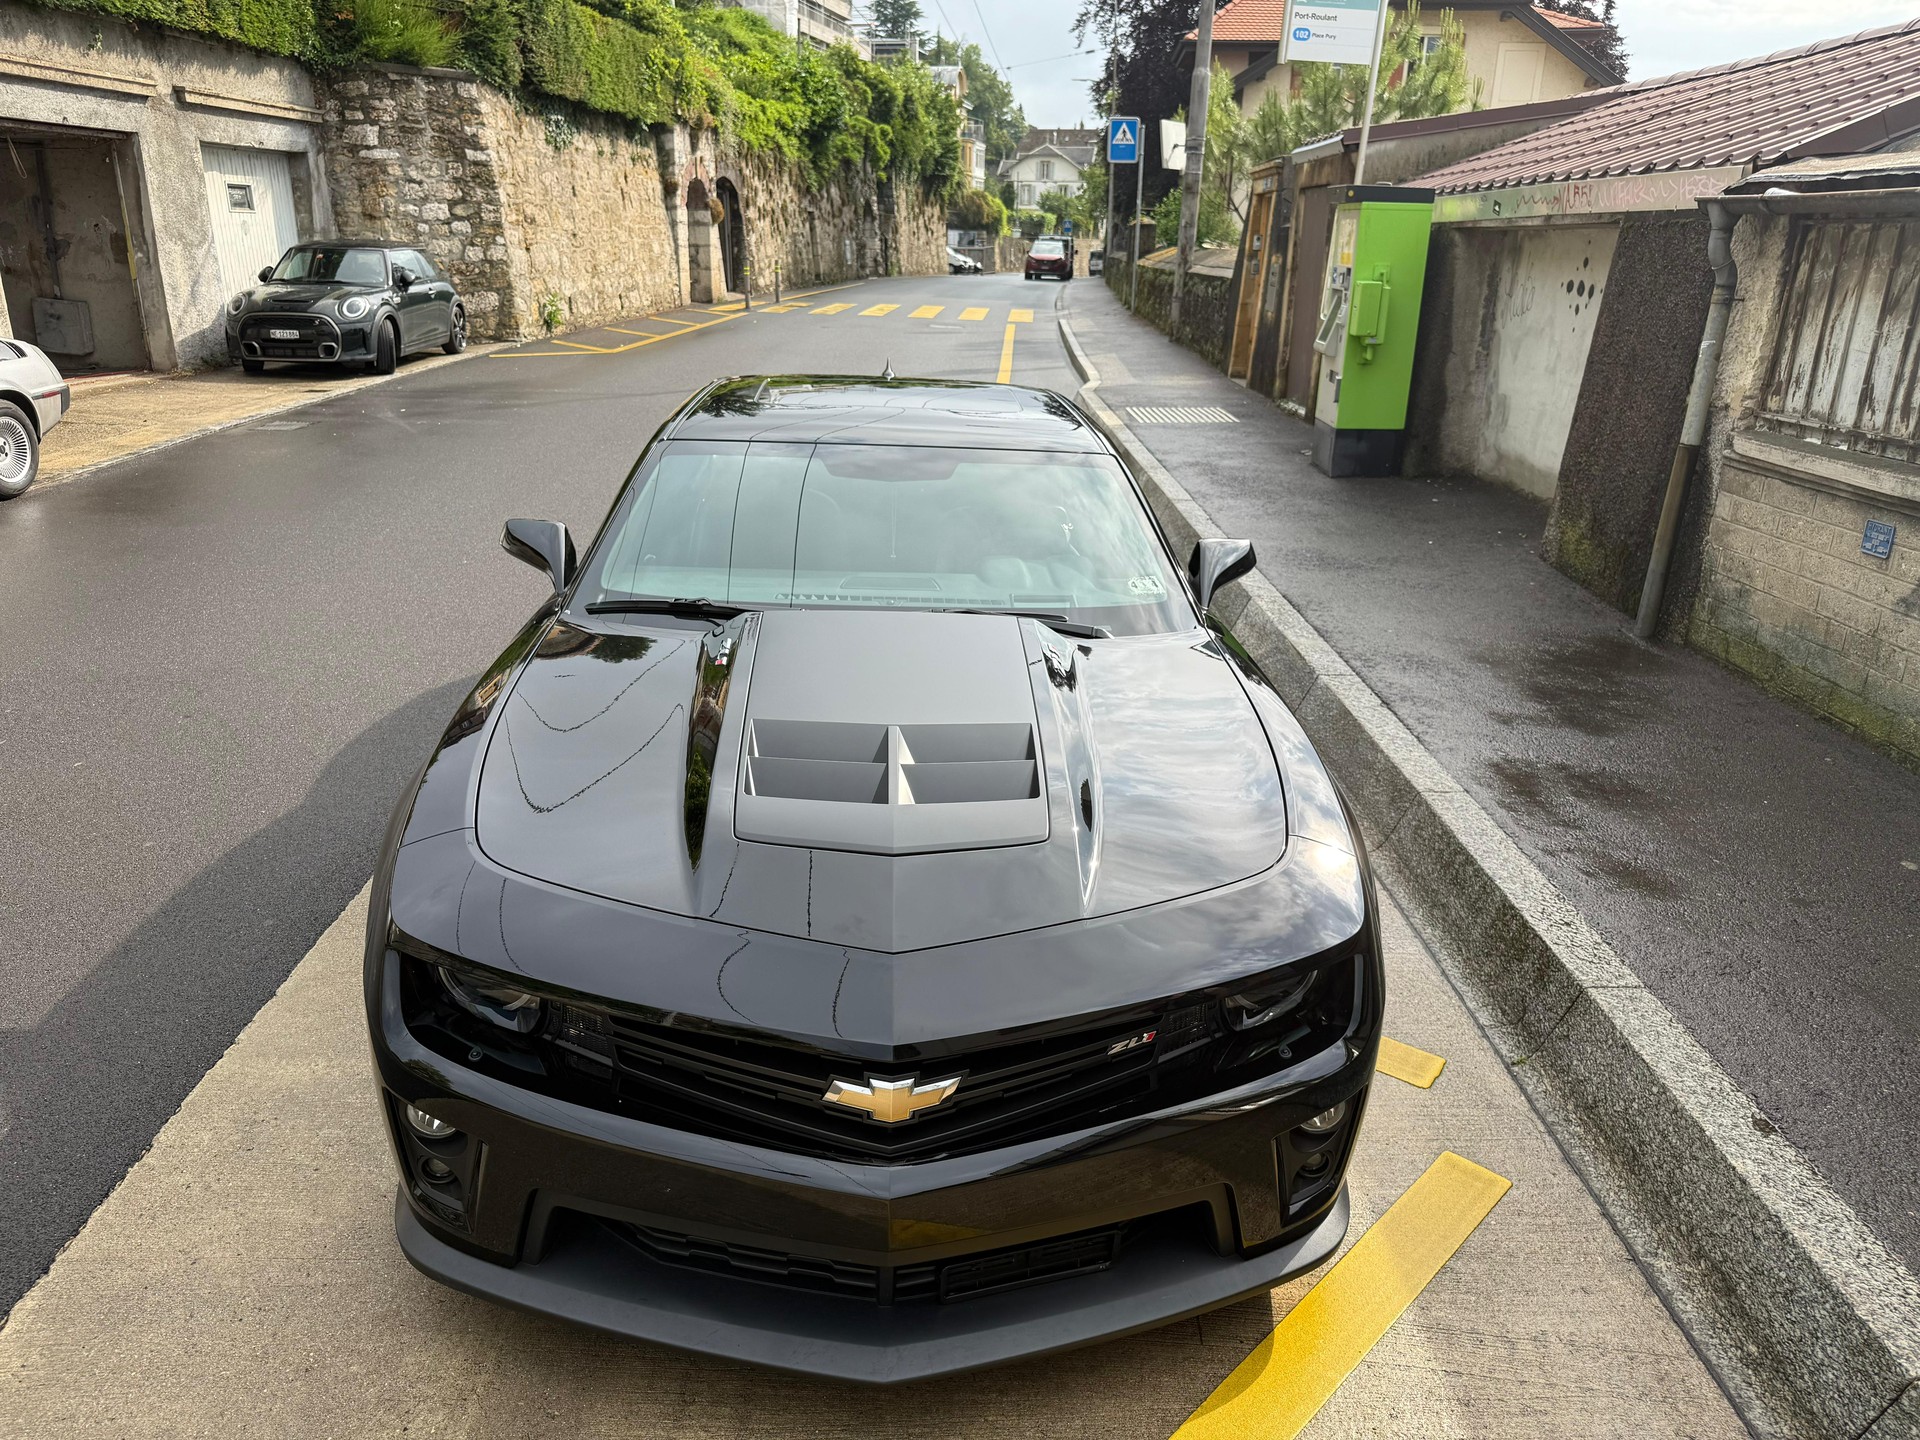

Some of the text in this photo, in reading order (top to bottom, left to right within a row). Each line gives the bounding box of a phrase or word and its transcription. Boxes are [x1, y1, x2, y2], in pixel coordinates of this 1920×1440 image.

[1294, 11, 1338, 22] Port-Roulant
[1295, 30, 1309, 39] 102
[1326, 33, 1337, 41] Pury
[1107, 1031, 1157, 1056] ZL1
